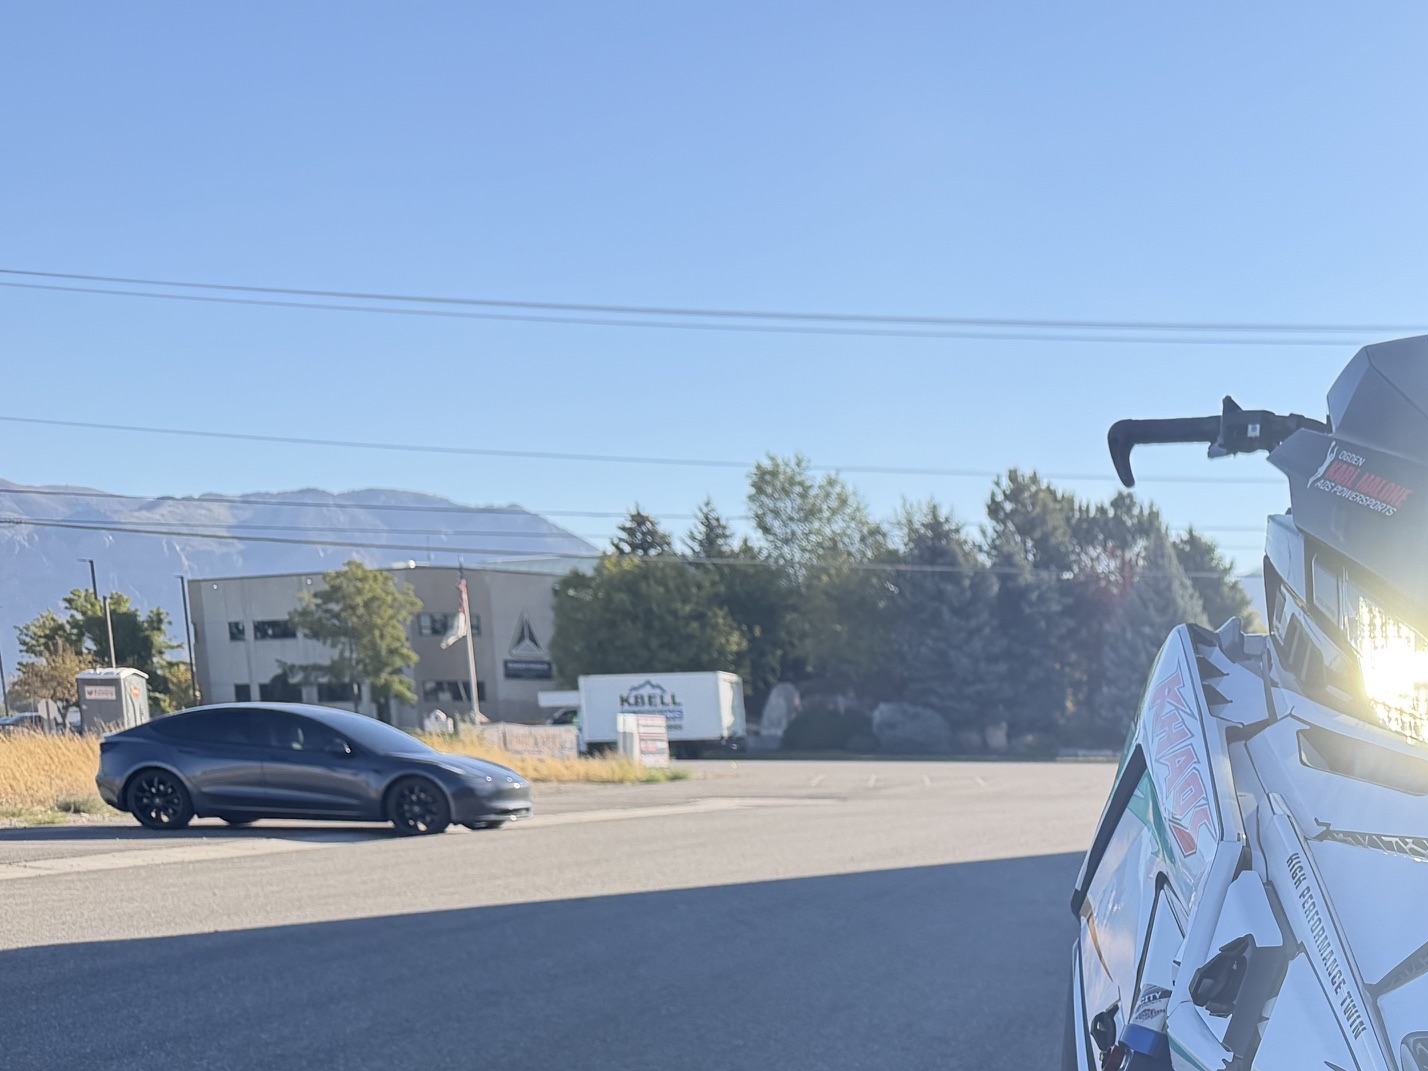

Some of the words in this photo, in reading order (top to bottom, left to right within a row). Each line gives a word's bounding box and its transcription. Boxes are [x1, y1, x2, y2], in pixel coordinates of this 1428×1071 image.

[1338, 450, 1366, 466] OGDEN
[1331, 484, 1397, 516] POWERSPORTS
[1287, 853, 1307, 889] HIGH
[1299, 886, 1346, 995] PERFORMANCE
[1340, 991, 1367, 1041] TWIN
